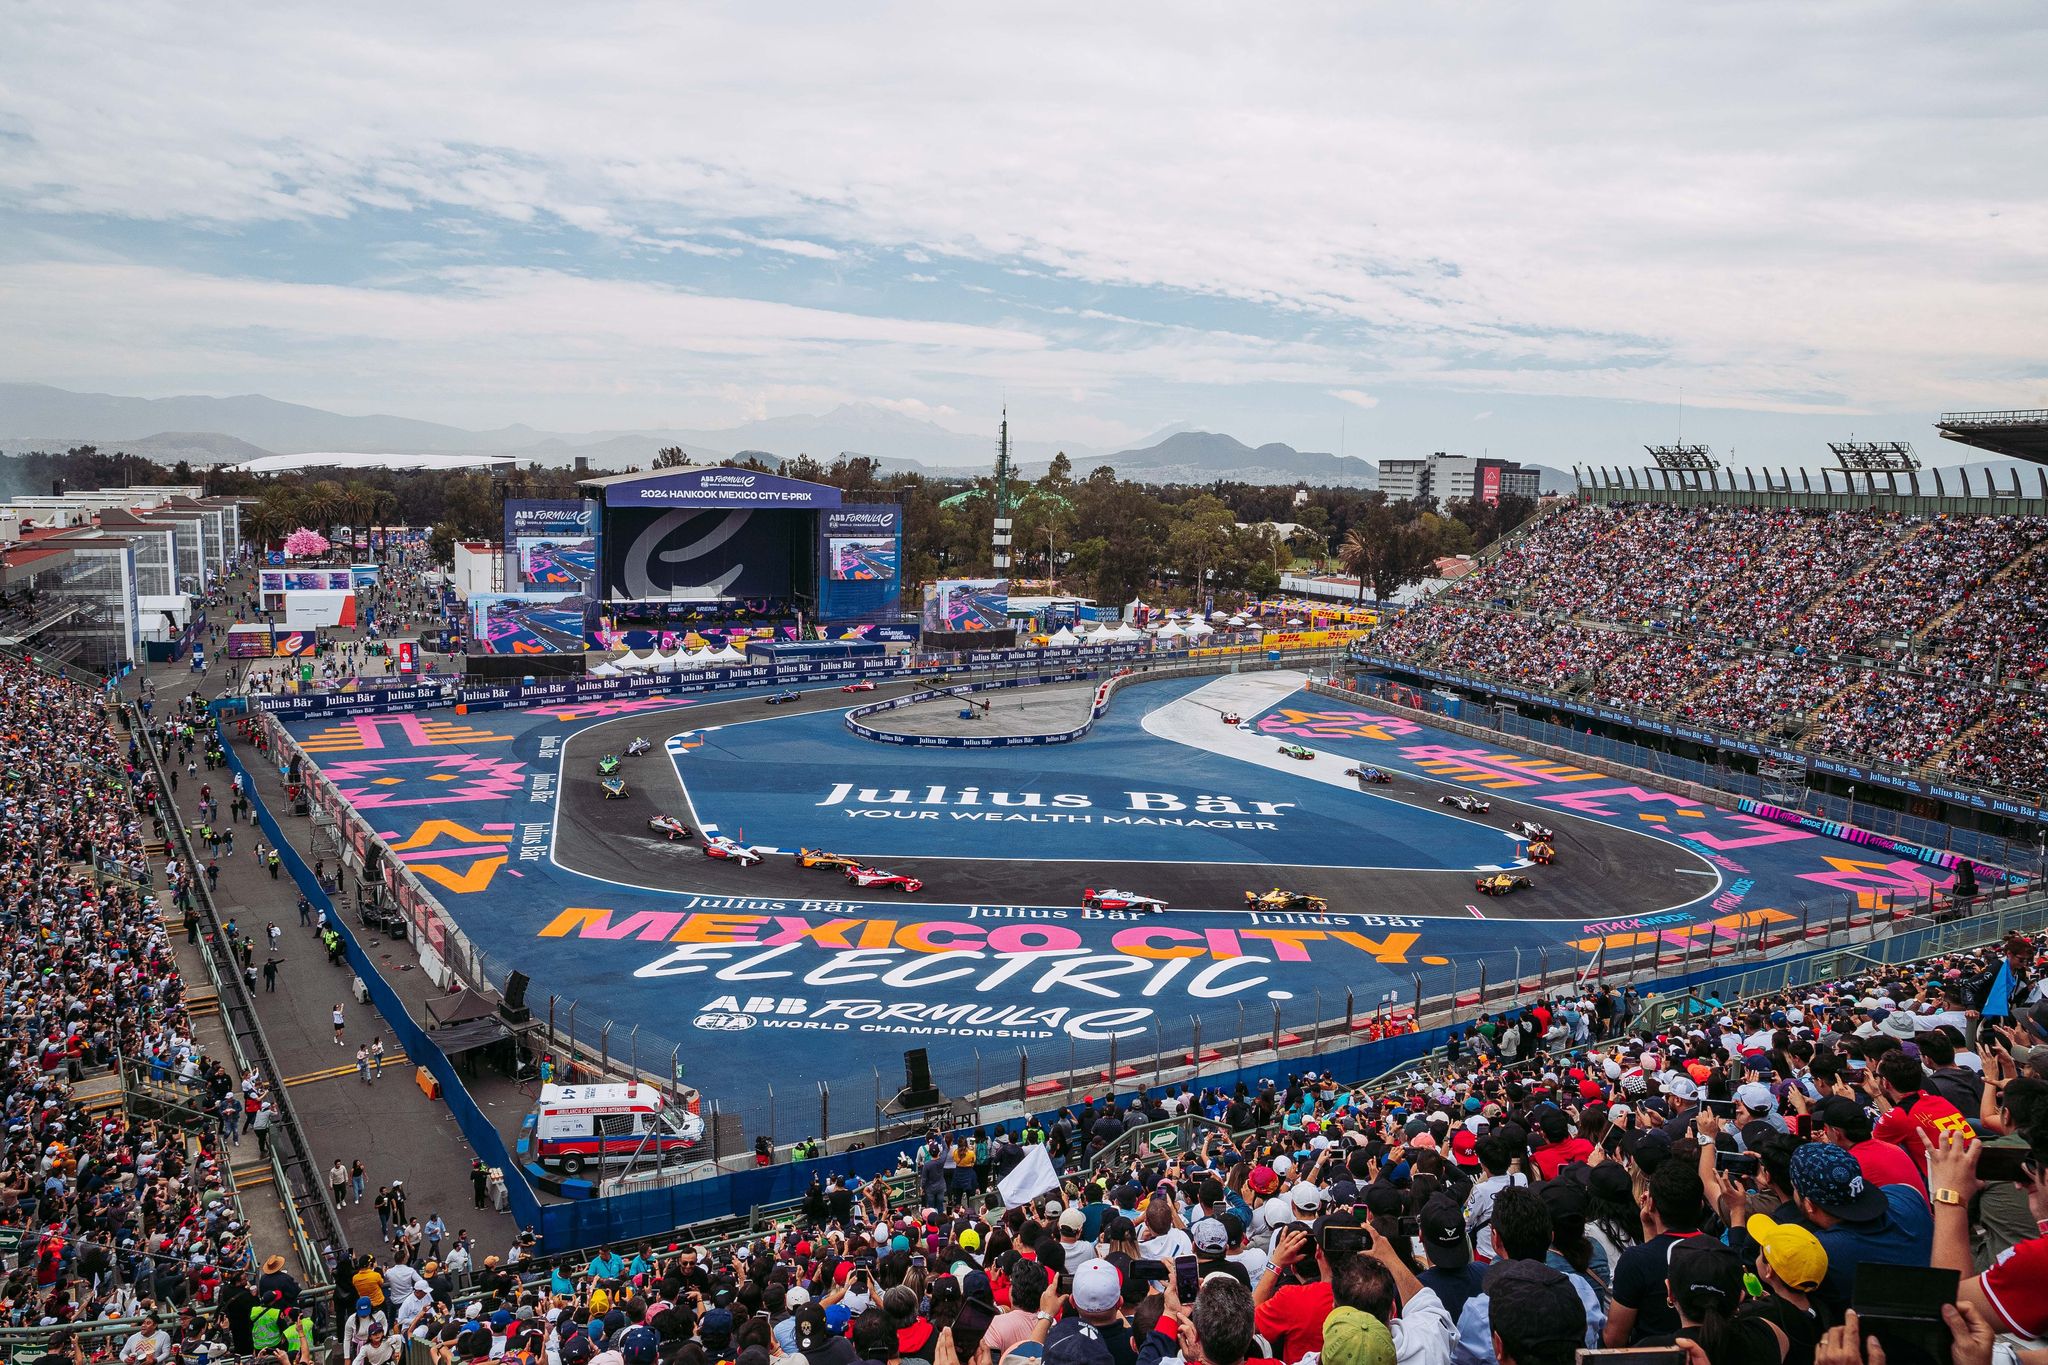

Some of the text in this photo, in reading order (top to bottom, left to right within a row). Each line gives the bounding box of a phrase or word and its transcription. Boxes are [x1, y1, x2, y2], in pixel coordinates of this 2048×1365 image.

[641, 490, 668, 498] 2024
[670, 491, 717, 499] HANKOOK
[719, 491, 757, 499] MEXICO
[759, 492, 780, 500] CITY
[534, 510, 578, 520] FORMULA
[846, 514, 882, 522] FORMULA
[1278, 634, 1300, 642] DHL
[1008, 650, 1037, 660] Julius Bär
[1044, 649, 1060, 658] Julius
[1078, 647, 1093, 656] Julius
[1110, 646, 1126, 654] Julius
[864, 658, 897, 669] Julius Bär
[972, 654, 989, 662] Julius
[776, 665, 797, 674] Julius
[821, 661, 856, 670] Julius Bär
[681, 672, 720, 683] Julius Bär
[730, 670, 752, 679] Julius
[753, 668, 767, 676] Bär
[577, 681, 601, 692] Julius
[604, 679, 620, 688] Bär
[630, 676, 671, 687] Julius Bär
[388, 688, 435, 701] Julius Bär
[463, 689, 510, 702] Julius Bär
[521, 685, 566, 697] Julius Bär
[260, 699, 313, 711] Julius Bär
[326, 694, 375, 707] Julius Bär
[1720, 737, 1748, 750] Julius Bär
[1815, 759, 1848, 773] Julius Bär
[1870, 771, 1905, 787] Julius Bär
[815, 783, 1295, 816] Julius Bär
[1930, 786, 1952, 798] Julius
[1955, 790, 1970, 801] Bär
[1993, 800, 2018, 812] Julius
[2020, 805, 2037, 817] Bär
[845, 809, 1280, 831] YOUR WEALTH MANAGER
[1800, 818, 1821, 829] MODE
[520, 822, 550, 861] Julius Bär
[1893, 843, 1918, 856] MODE
[685, 896, 864, 914] Julius Bär
[968, 906, 1146, 922] Julius Bär
[1249, 911, 1425, 928] Julius Bär
[537, 907, 1449, 965] MEXICO CITY.
[633, 941, 1293, 999] ELECTRIC.
[700, 995, 809, 1016] ABB
[810, 999, 1070, 1026] FORMULA
[763, 1019, 851, 1030] WORLD
[859, 1024, 1053, 1038] CHAMPIONSHIP
[562, 1088, 576, 1099] 41
